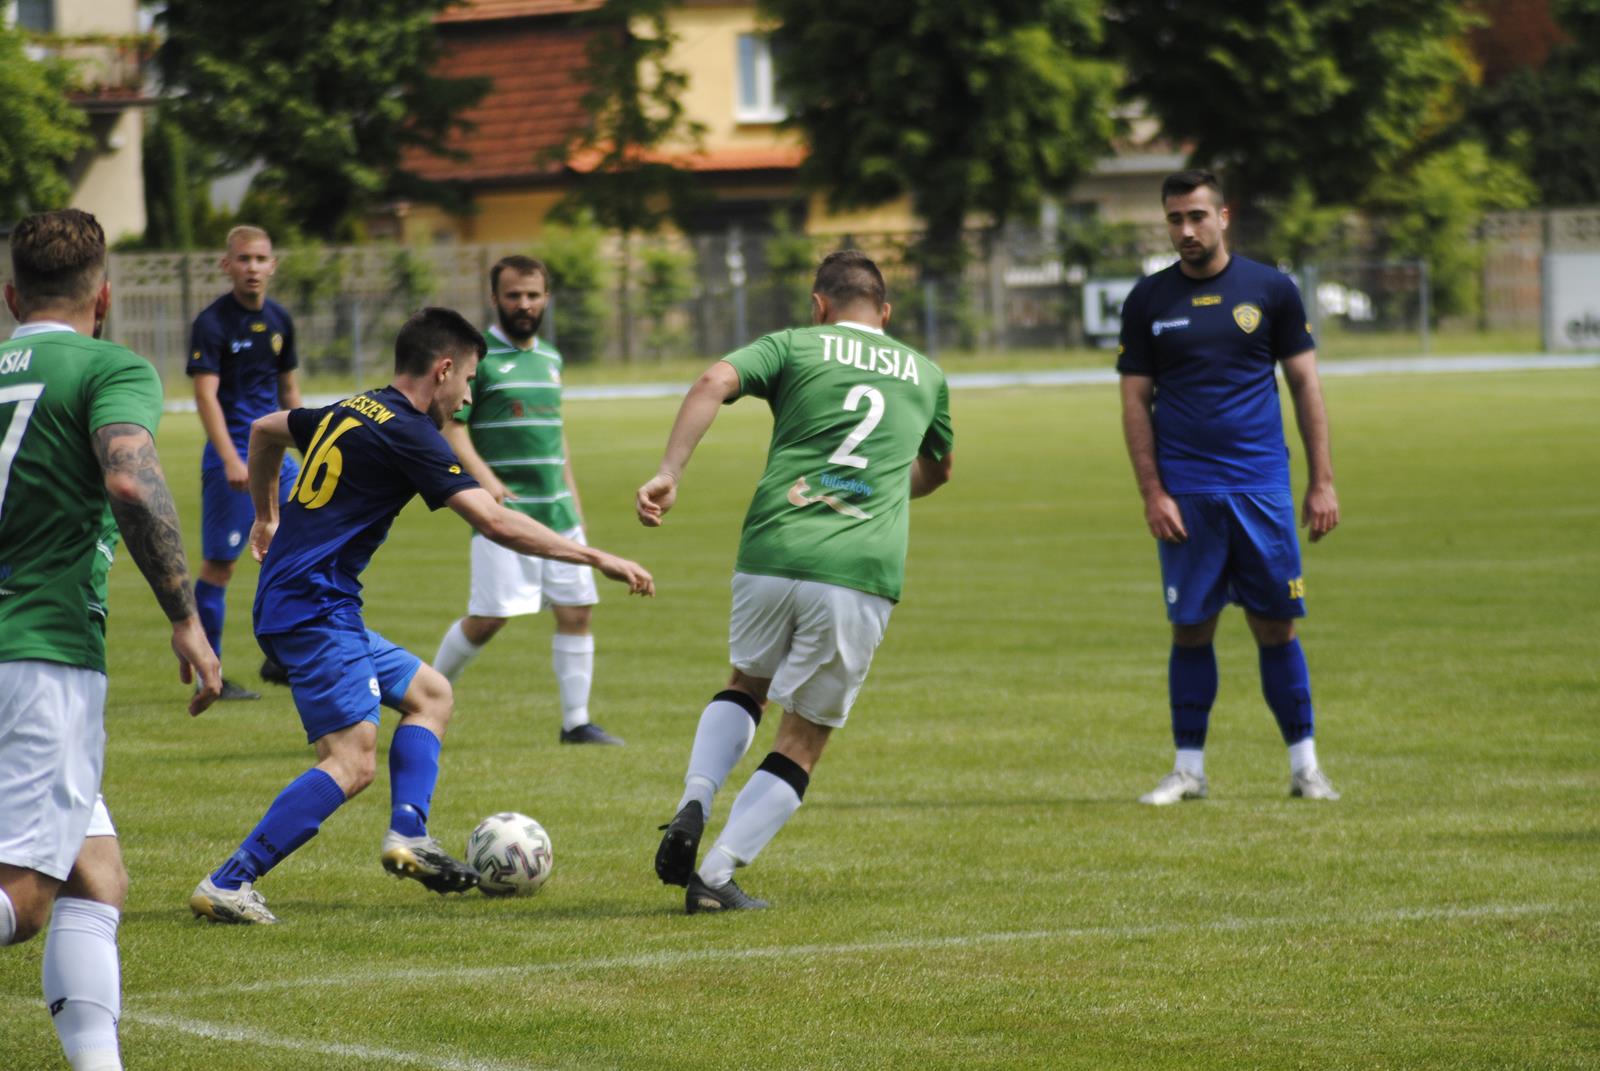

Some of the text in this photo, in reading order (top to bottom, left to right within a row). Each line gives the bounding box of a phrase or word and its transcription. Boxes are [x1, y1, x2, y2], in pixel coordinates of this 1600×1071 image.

[820, 334, 919, 386] TULISIA
[0, 383, 45, 520] 7
[287, 411, 363, 510] 16
[827, 384, 885, 469] 2
[820, 472, 873, 497] Tuliszków
